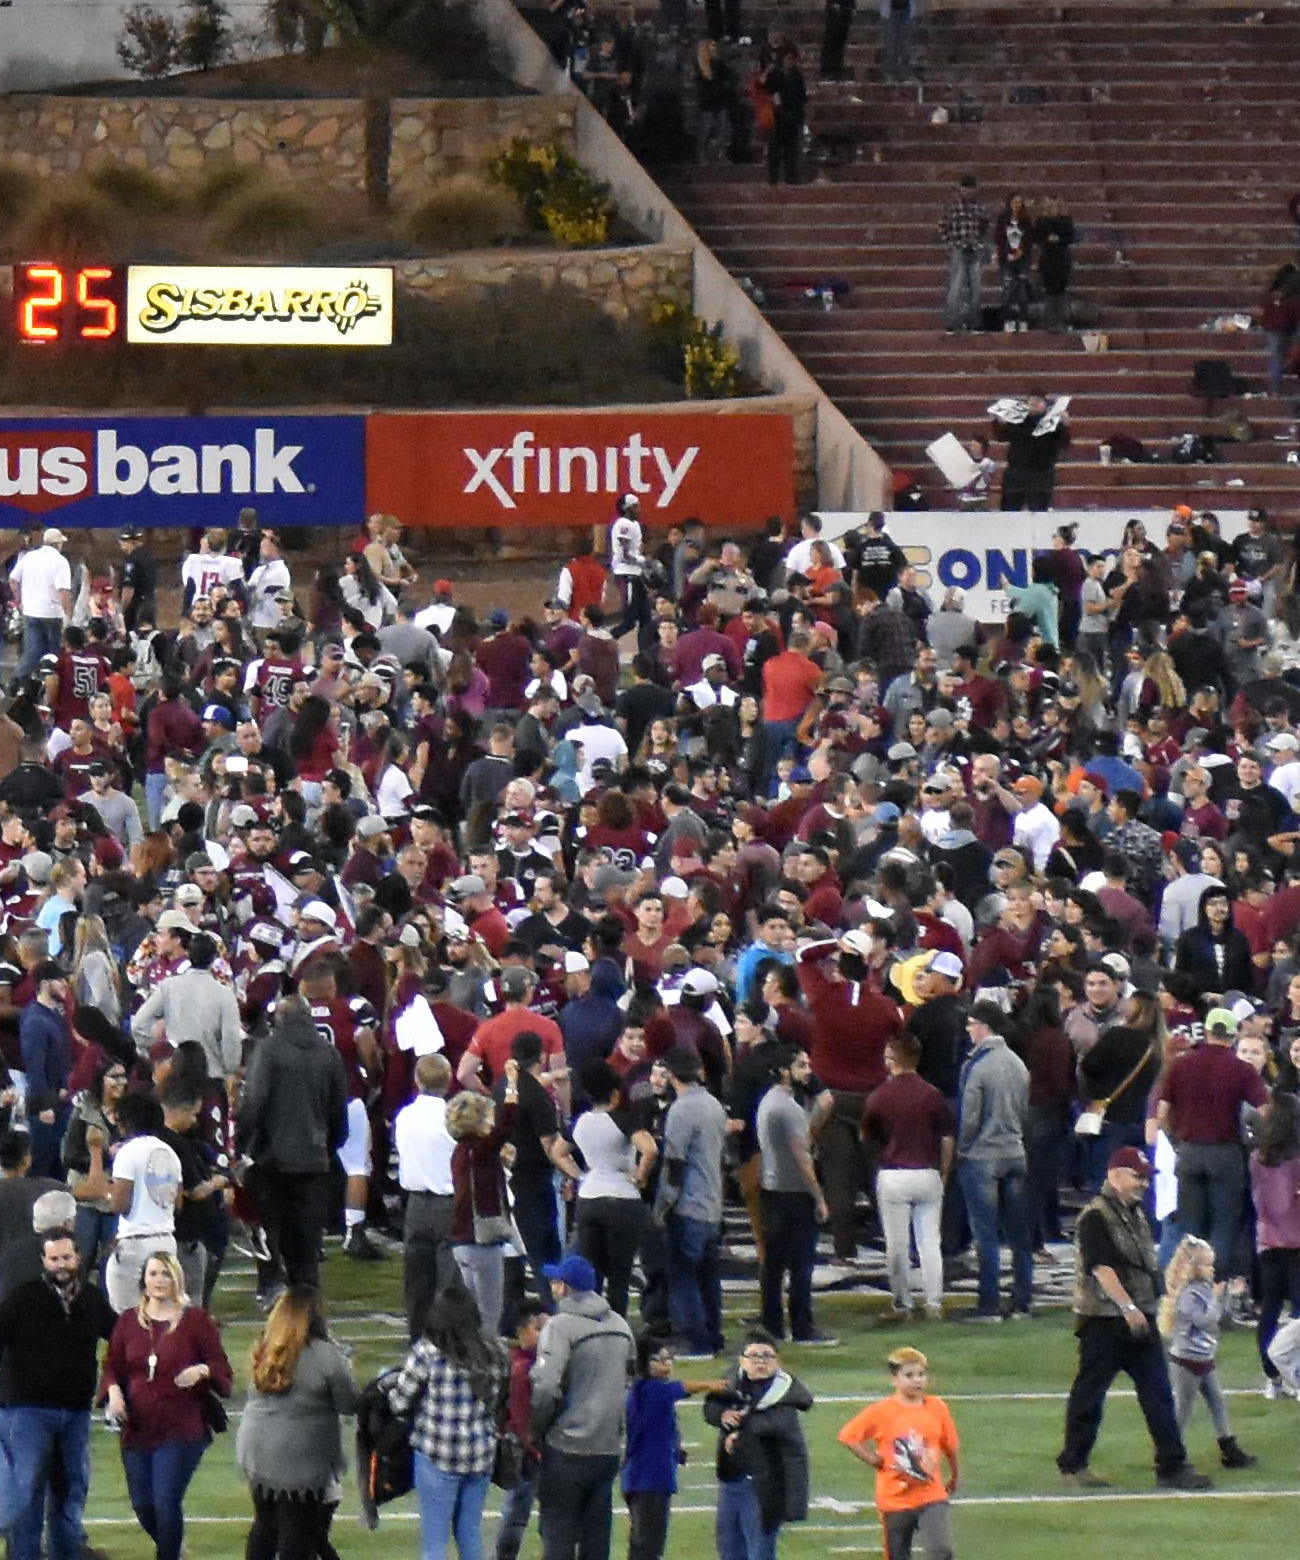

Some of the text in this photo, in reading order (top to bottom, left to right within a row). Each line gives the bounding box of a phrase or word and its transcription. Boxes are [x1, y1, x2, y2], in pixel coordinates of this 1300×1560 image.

[24, 267, 117, 339] 25
[138, 279, 381, 335] SISBARRO
[463, 430, 700, 508] xfinity
